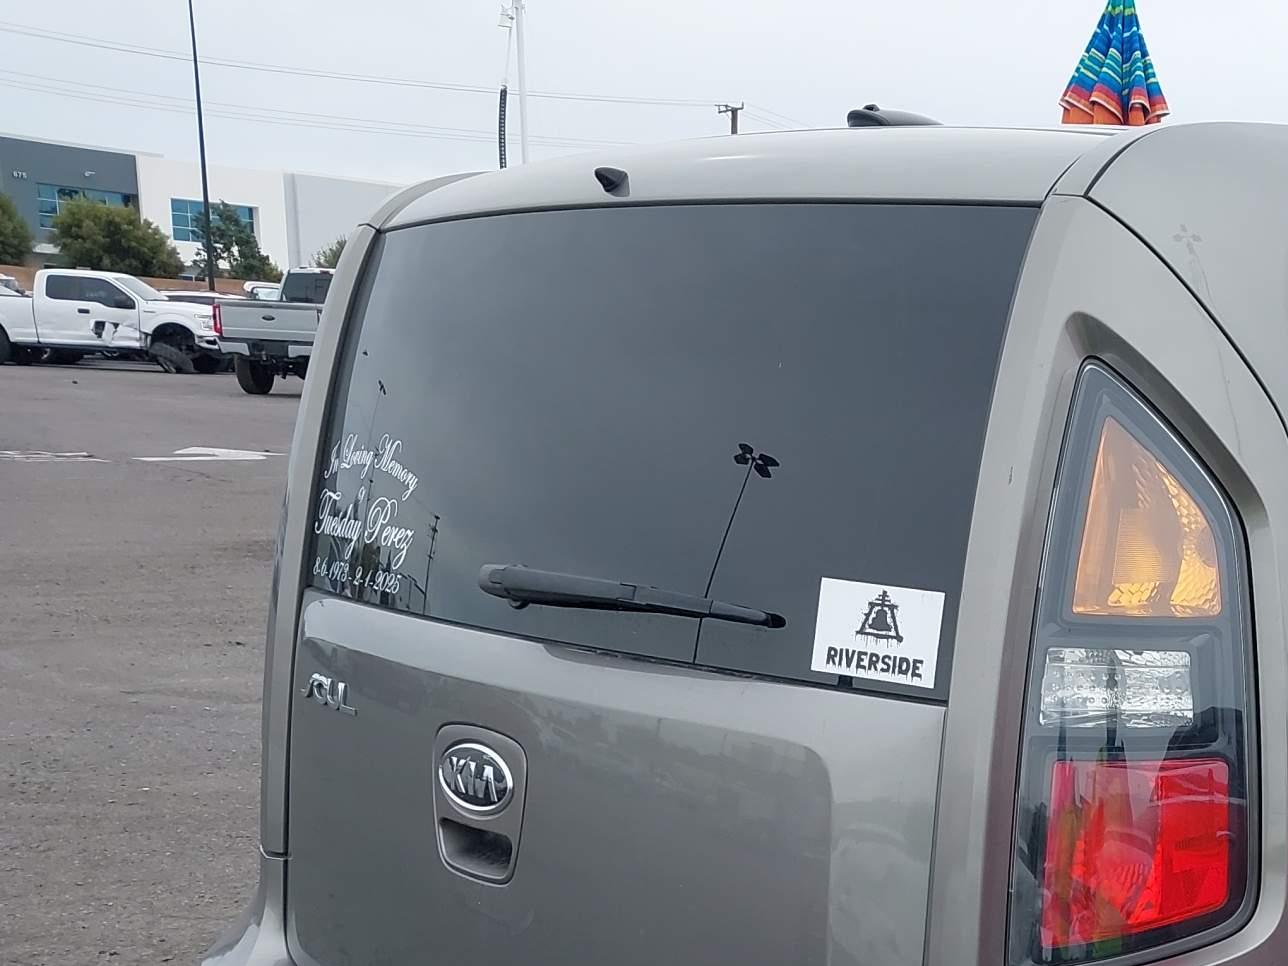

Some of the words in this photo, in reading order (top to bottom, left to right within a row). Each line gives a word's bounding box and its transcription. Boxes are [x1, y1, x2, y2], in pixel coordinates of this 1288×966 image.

[324, 440, 340, 479] In
[341, 433, 373, 479] Loving
[374, 433, 419, 502] Memory
[315, 488, 362, 559] Tuesday
[364, 496, 415, 570] Perez
[825, 645, 925, 680] RIVERSIDE
[444, 754, 500, 803] KIA
